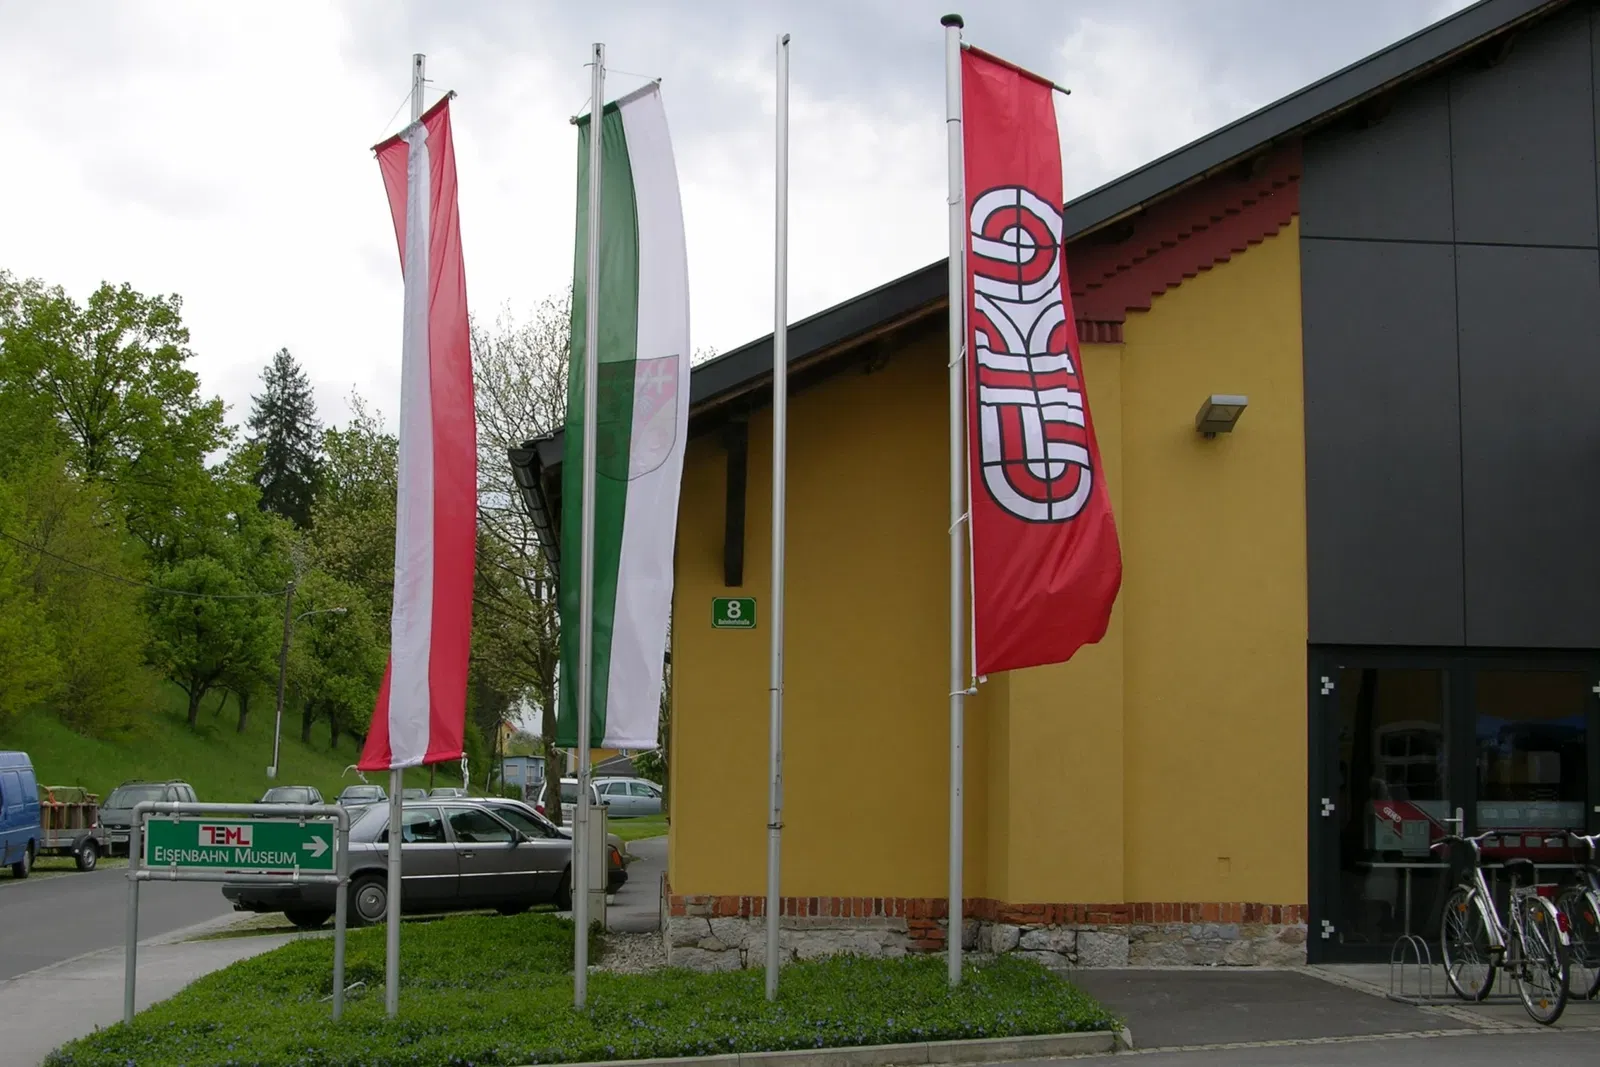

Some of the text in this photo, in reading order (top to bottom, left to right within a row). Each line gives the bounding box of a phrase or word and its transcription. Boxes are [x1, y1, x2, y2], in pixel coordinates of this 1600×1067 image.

[727, 600, 742, 619] 8
[202, 826, 250, 845] TEML
[154, 846, 297, 865] EISENBAHN MUSEUM
